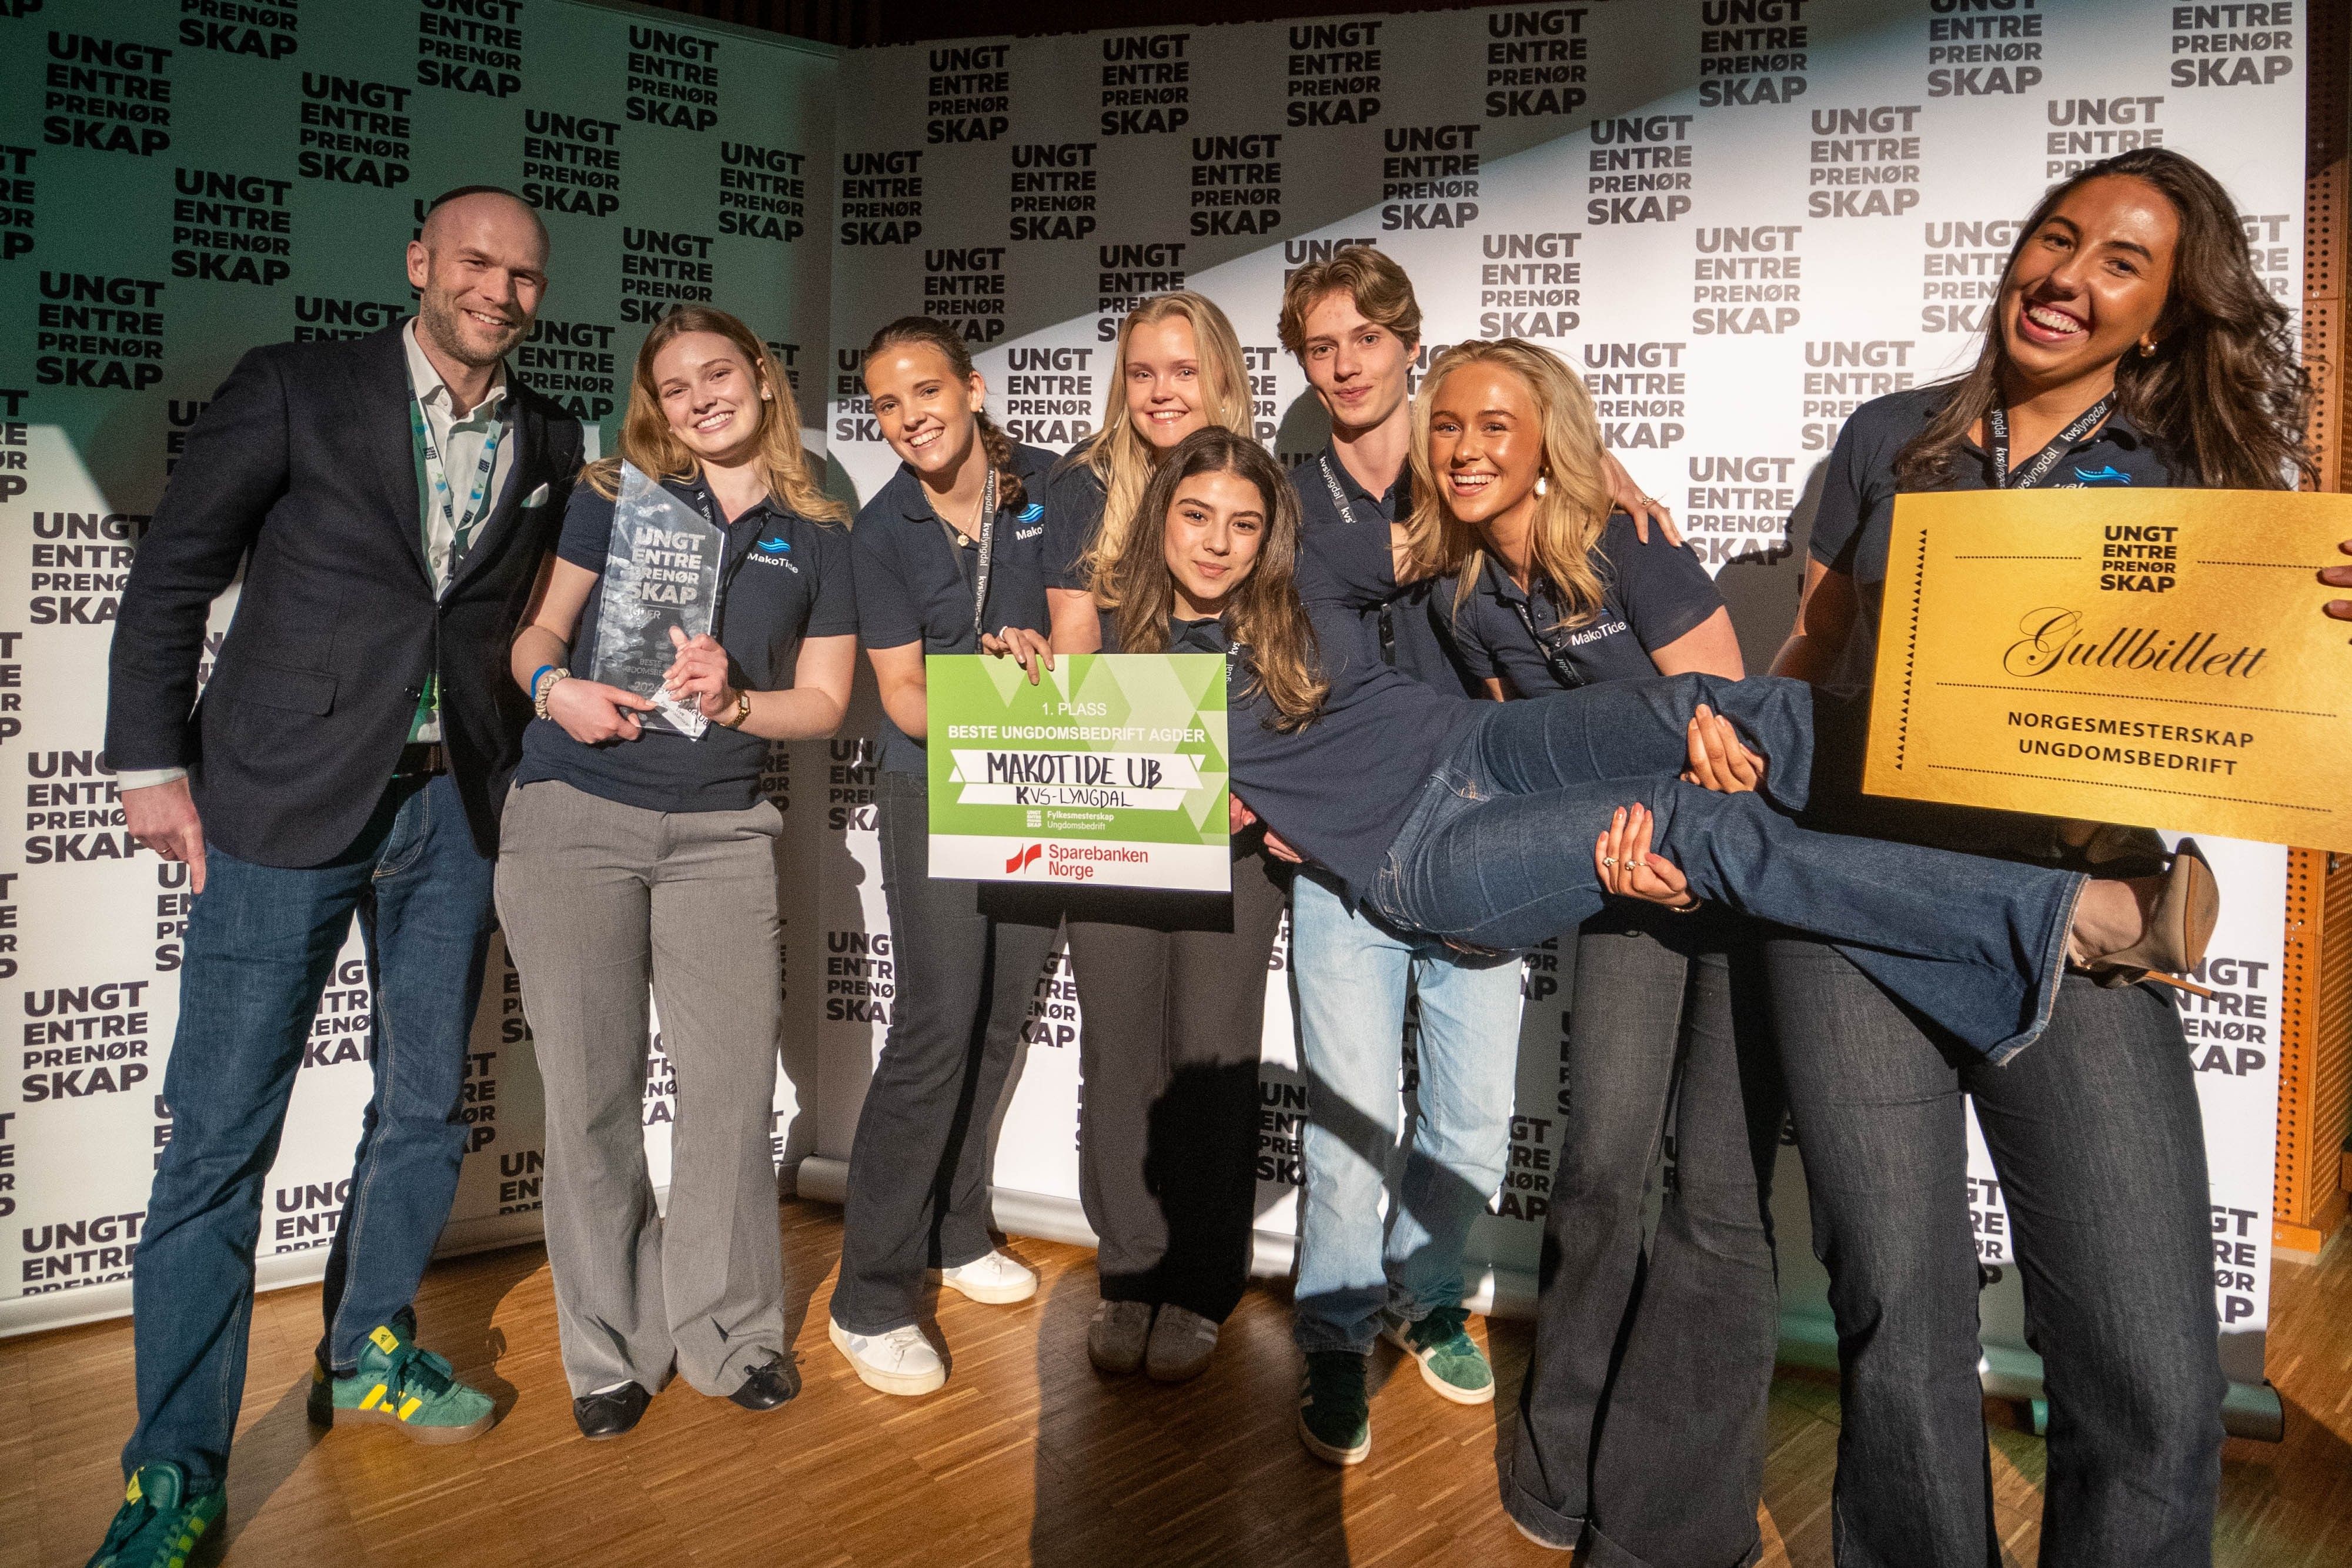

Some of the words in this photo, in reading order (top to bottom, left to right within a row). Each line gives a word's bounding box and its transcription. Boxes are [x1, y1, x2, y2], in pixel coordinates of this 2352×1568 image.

[1488, 9, 1587, 37] UNGT
[1702, 0, 1807, 25] UNGT
[2173, 3, 2290, 28] ENTRE
[179, 18, 298, 60] SKAP
[419, 14, 520, 49] ENTRE
[1289, 22, 1381, 49] UNGT
[1929, 14, 2042, 40] ENTRE
[47, 32, 172, 73] UNGT
[629, 26, 718, 61] UNGT
[1103, 35, 1188, 60] UNGT
[1488, 39, 1586, 63] ENTRE
[1701, 28, 1806, 52] ENTRE
[2172, 32, 2290, 53] PRENØR
[419, 38, 520, 69] PRENØR
[930, 46, 1009, 71] UNGT
[1288, 51, 1380, 75] ENTRE
[1700, 54, 1806, 75] PRENØR
[1929, 44, 2040, 63] PRENØR
[417, 62, 520, 96] SKAP
[628, 53, 717, 85] ENTRE
[1102, 62, 1188, 85] ENTRE
[1487, 66, 1585, 85] PRENØR
[2171, 57, 2291, 88] SKAP
[46, 64, 170, 102] ENTRE
[302, 73, 410, 111] UNGT
[627, 77, 716, 104] PRENØR
[928, 72, 1008, 95] ENTRE
[1288, 77, 1379, 96] PRENØR
[1699, 78, 1806, 106] SKAP
[1927, 68, 2041, 97] SKAP
[45, 92, 169, 125] PRENØR
[928, 97, 1007, 115] PRENØR
[1102, 88, 1187, 106] PRENØR
[1485, 89, 1585, 117] SKAP
[300, 103, 409, 138] ENTRE
[626, 98, 717, 130] SKAP
[1101, 109, 1188, 135] SKAP
[1287, 99, 1379, 126] SKAP
[1811, 105, 1921, 134] UNGT
[2047, 96, 2164, 125] UNGT
[44, 117, 169, 155] SKAP
[524, 110, 620, 144] UNGT
[927, 118, 1007, 143] SKAP
[1384, 125, 1480, 151] UNGT
[1589, 115, 1692, 143] UNGT
[300, 129, 409, 159] PRENØR
[524, 138, 619, 169] ENTRE
[1011, 144, 1096, 167] UNGT
[1192, 135, 1281, 160] UNGT
[1810, 138, 1919, 162] ENTRE
[298, 152, 409, 187] SKAP
[720, 142, 805, 173] UNGT
[843, 152, 922, 174] UNGT
[1384, 155, 1481, 178] ENTRE
[1589, 146, 1690, 170] ENTRE
[175, 168, 292, 205] UNGT
[523, 163, 618, 189] PRENØR
[720, 169, 803, 198] ENTRE
[1011, 171, 1095, 191] ENTRE
[1192, 163, 1280, 185] ENTRE
[1589, 173, 1690, 193] PRENØR
[1810, 166, 1919, 185] PRENØR
[520, 185, 619, 215] SKAP
[843, 178, 921, 198] ENTRE
[1191, 189, 1279, 206] PRENØR
[1381, 182, 1477, 200] PRENØR
[173, 199, 290, 233] ENTRE
[720, 192, 803, 216] PRENØR
[842, 202, 921, 216] PRENØR
[1011, 196, 1095, 211] PRENØR
[1588, 196, 1690, 225] SKAP
[1808, 190, 1919, 218] SKAP
[719, 212, 803, 241] SKAP
[1010, 217, 1095, 240] SKAP
[1190, 210, 1279, 235] SKAP
[1382, 203, 1478, 230] SKAP
[173, 227, 289, 255] PRENØR
[623, 228, 713, 258] UNGT
[841, 222, 921, 245] SKAP
[1483, 233, 1581, 258] UNGT
[1696, 226, 1802, 252] UNGT
[171, 251, 289, 285] SKAP
[622, 255, 711, 282] ENTRE
[925, 248, 1005, 270] UNGT
[1100, 244, 1185, 268] UNGT
[1695, 258, 1800, 279] ENTRE
[924, 276, 1004, 295] ENTRE
[1099, 272, 1185, 293] ENTRE
[1482, 263, 1579, 284] ENTRE
[39, 271, 164, 306] UNGT
[622, 279, 711, 302] PRENØR
[1481, 290, 1579, 306] PRENØR
[1694, 286, 1799, 302] PRENØR
[38, 304, 162, 335] ENTRE
[924, 300, 1003, 315] PRENØR
[1480, 313, 1579, 337] SKAP
[1692, 309, 1799, 335] SKAP
[38, 333, 162, 358] PRENØR
[1584, 343, 1686, 367] UNGT
[1805, 341, 1915, 366] UNGT
[520, 346, 614, 372] ENTRE
[1008, 349, 1092, 370] UNGT
[36, 357, 162, 390] SKAP
[1008, 377, 1090, 394] ENTRE
[1008, 401, 1090, 414] PRENØR
[1006, 420, 1091, 444] SKAP
[2060, 402, 2108, 442] kvslyngdal
[1319, 456, 1344, 500] kvslyngdal
[1689, 458, 1793, 482] UNGT
[2014, 447, 2060, 489] vslyngdal
[985, 470, 995, 513] kvslyngdal
[1688, 487, 1794, 510] ENTRE
[1015, 523, 1044, 541] Mako
[1688, 514, 1793, 533] PRENØR
[2105, 526, 2179, 542] UNGT
[636, 527, 706, 551] UNGT
[980, 523, 992, 566] kvslyngdal
[2103, 544, 2177, 559] ENTRE
[632, 548, 702, 570] ENTRE
[747, 553, 799, 574] MakoTide
[2102, 560, 2176, 573] PRENØR
[626, 581, 698, 605] SKAP
[2100, 574, 2175, 593] SKAP
[1571, 621, 1626, 646] MakoTide
[2003, 607, 2269, 678] Gullbillett
[1042, 703, 1054, 716] 1.
[1058, 703, 1107, 716] PLASS
[948, 726, 998, 739] BESTE
[1001, 726, 1145, 742] UNGDOMSBEDRIFT
[1148, 728, 1205, 743] AGDER
[2008, 711, 2254, 748] NORGESMESTERSKAP
[2019, 738, 2238, 776] UNGDOMSBEDRIFT
[987, 753, 1116, 785] MAKOTIDE
[1127, 758, 1162, 789] UB
[1016, 786, 1133, 808] KVS-LYNGDAL
[1047, 811, 1114, 822] Fylkesmesterskap
[1047, 821, 1105, 830] Ungdomsbedrift
[1049, 844, 1148, 863] Sparebanken
[1049, 861, 1094, 880] Norge
[24, 981, 148, 1016] UNGT
[24, 1012, 147, 1045] ENTRE
[24, 1041, 146, 1068] PRENØR
[22, 1065, 147, 1102] SKAP
[22, 1211, 146, 1253] UNGT
